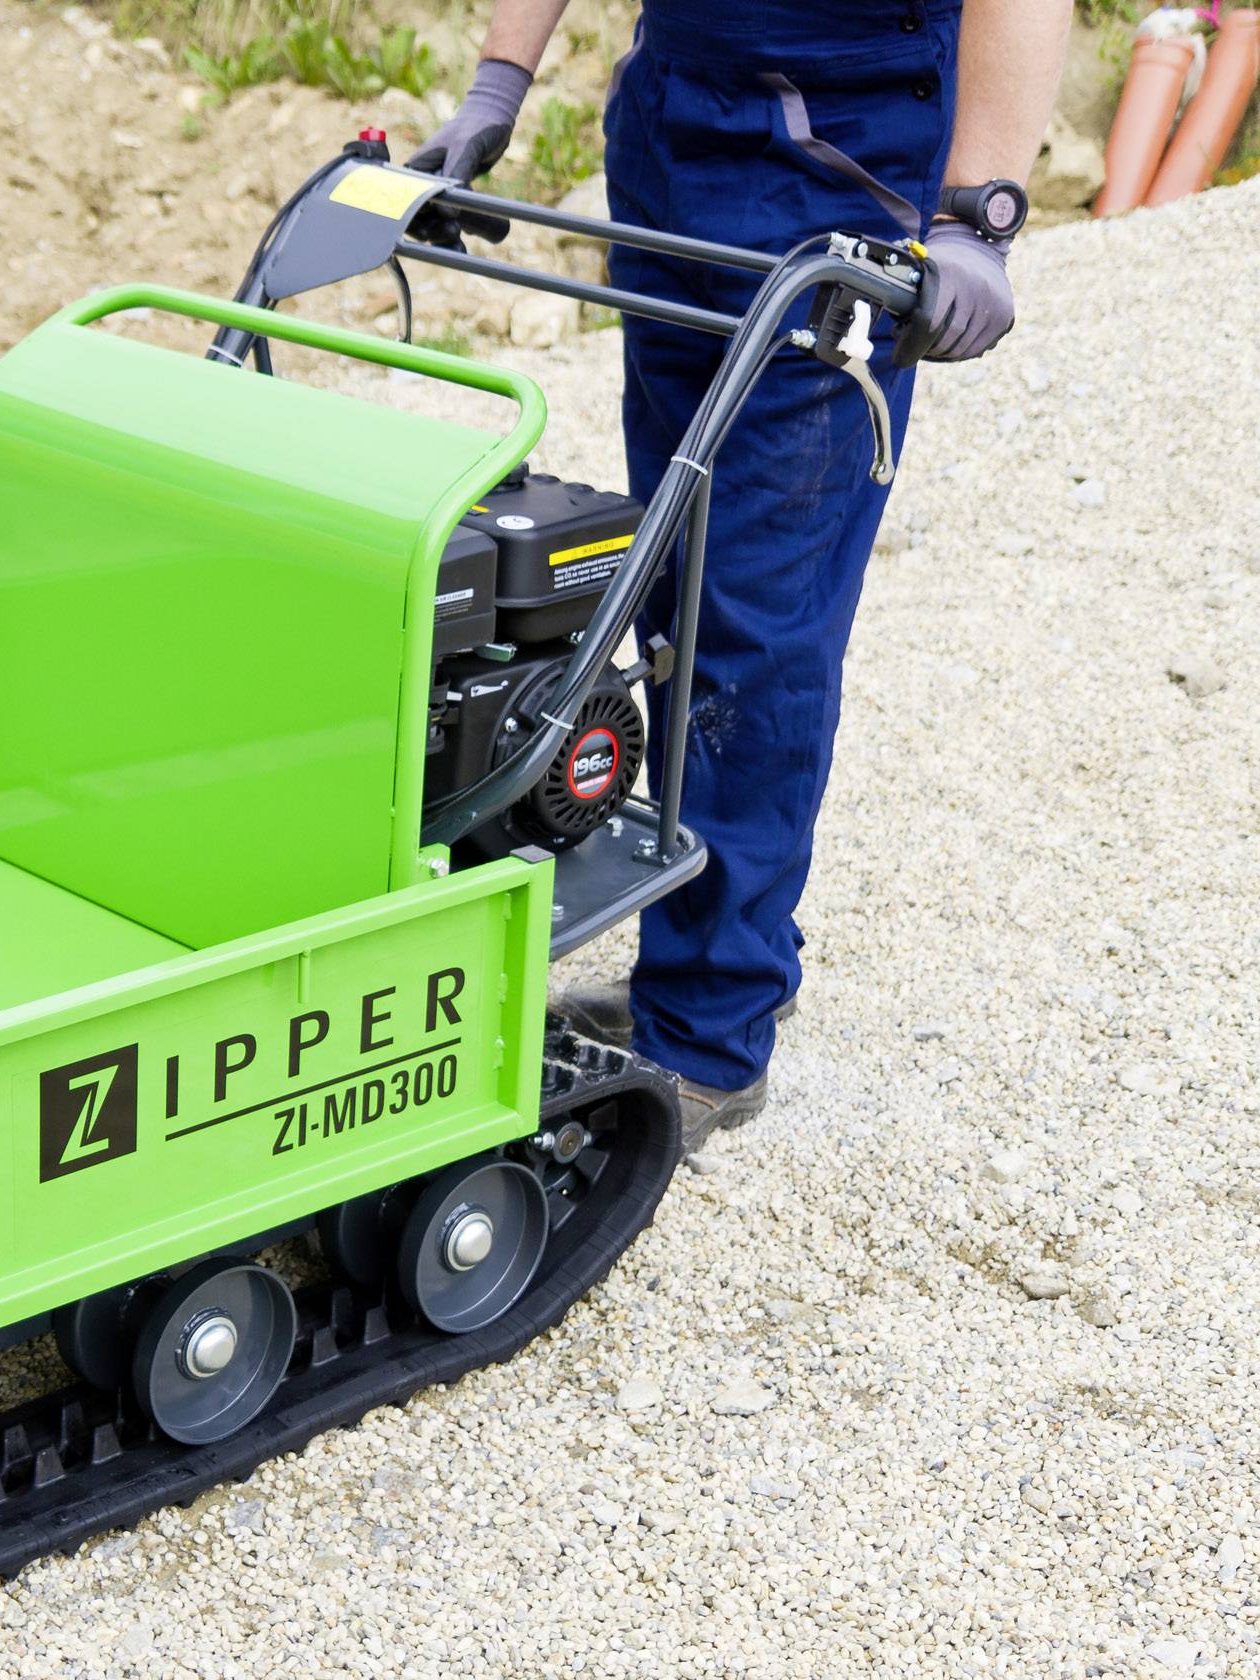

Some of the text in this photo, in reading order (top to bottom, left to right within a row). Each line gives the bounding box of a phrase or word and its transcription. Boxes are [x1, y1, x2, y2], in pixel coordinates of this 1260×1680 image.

[573, 753, 613, 778] 196cc
[50, 967, 466, 1172] ZIPPER
[272, 1054, 458, 1156] ZI-MD300
